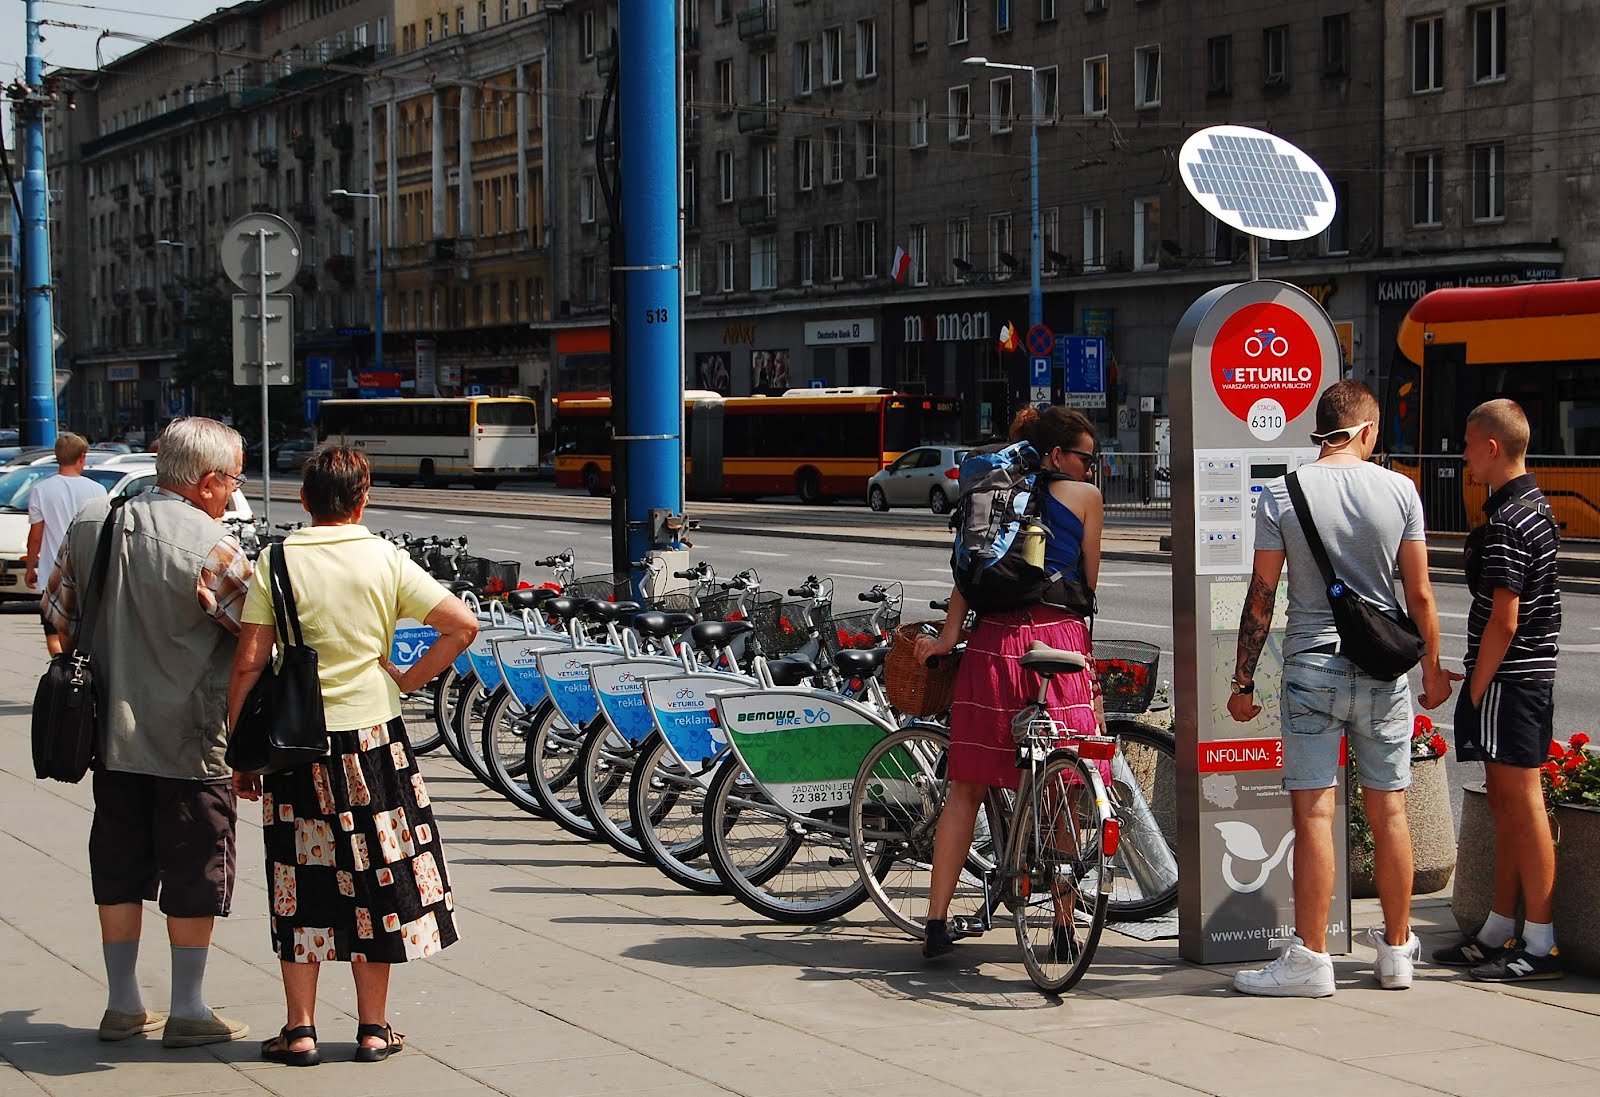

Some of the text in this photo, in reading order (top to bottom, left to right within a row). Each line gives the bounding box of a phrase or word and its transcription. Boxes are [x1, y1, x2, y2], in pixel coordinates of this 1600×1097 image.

[1527, 269, 1556, 278] KANTOR
[1378, 280, 1427, 301] KANTOR
[646, 308, 668, 324] 513
[817, 330, 850, 340] Deutsche Bank
[1034, 359, 1047, 378] P
[1222, 367, 1312, 382] VETURILO
[1251, 415, 1282, 428] 6310
[1215, 574, 1243, 582] URSYNÓW
[519, 669, 541, 679] rekla
[667, 699, 704, 708] VETURILO
[674, 715, 714, 726] reklam
[737, 710, 796, 722] BEMOWO
[776, 716, 801, 726] BIKE
[1206, 747, 1270, 764] INFOLINIA:
[791, 782, 831, 794] ZADZWOŃ
[838, 782, 853, 791] JED
[792, 790, 852, 803] 22 382 13 1
